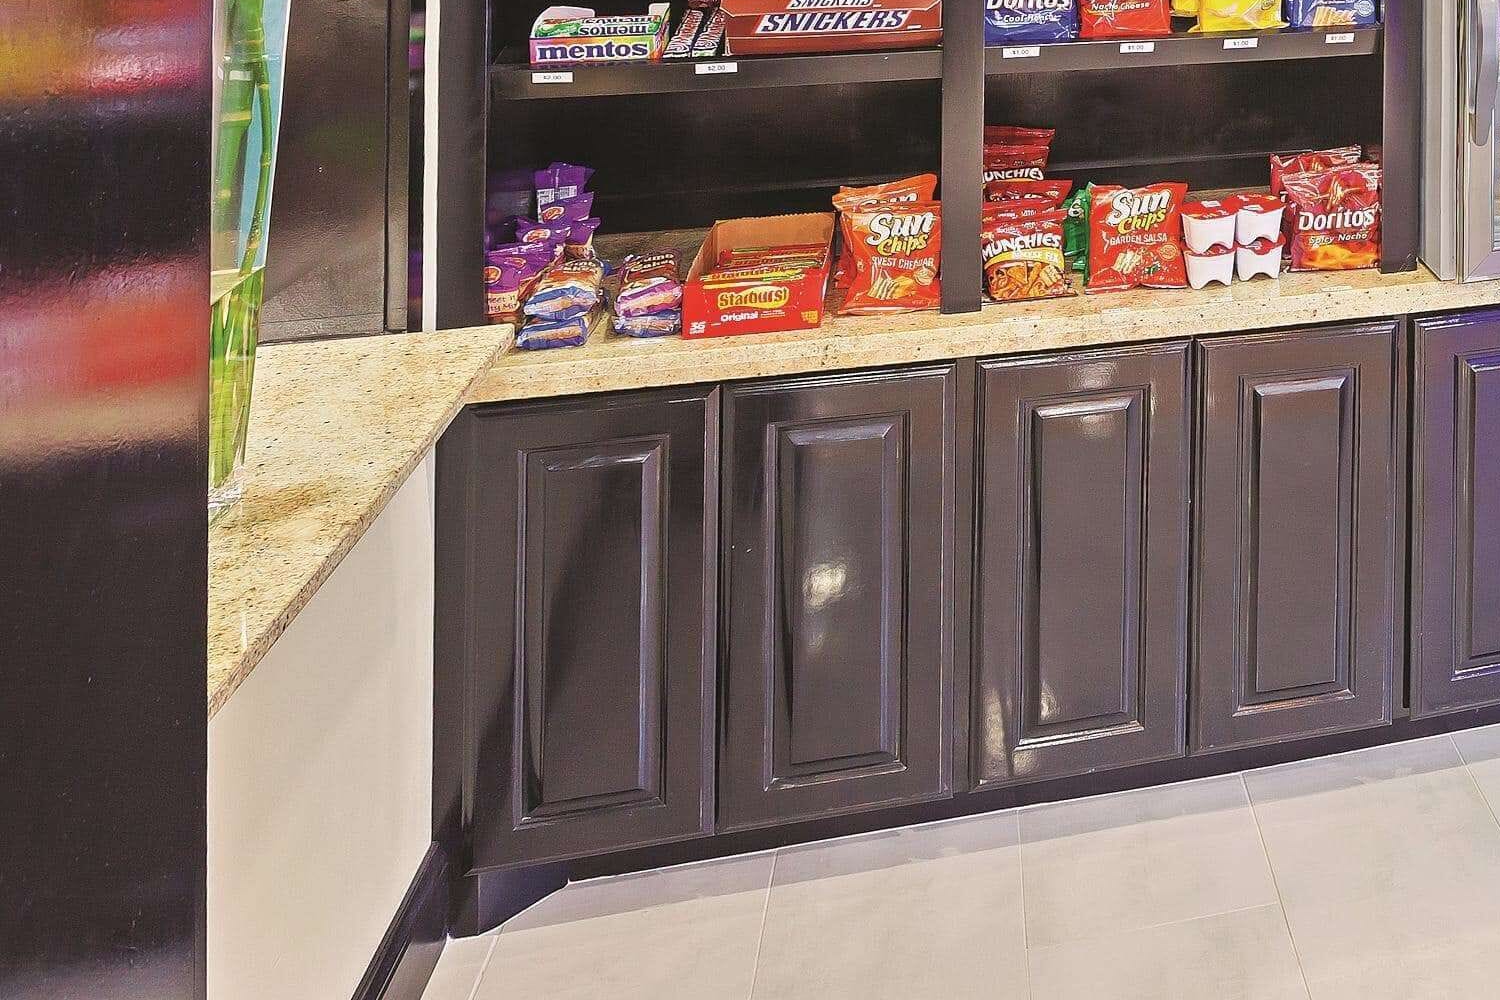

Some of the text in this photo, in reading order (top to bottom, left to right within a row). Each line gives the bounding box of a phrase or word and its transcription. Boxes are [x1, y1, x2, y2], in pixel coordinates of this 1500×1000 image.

[761, 10, 909, 33] SNICKERS
[537, 41, 648, 60] mentos
[983, 167, 1044, 183] UNCHIE
[1107, 190, 1171, 226] Sun
[1298, 207, 1376, 231] Doritos
[865, 212, 935, 246] Sun
[1117, 208, 1166, 235] Chips
[877, 234, 928, 257] Chips
[981, 232, 1062, 262] MUNCHIES
[1109, 234, 1168, 245] GARDEN SALSA
[1309, 231, 1368, 246] Spicy Nacho
[719, 288, 788, 307] Starburst
[721, 311, 759, 322] Original
